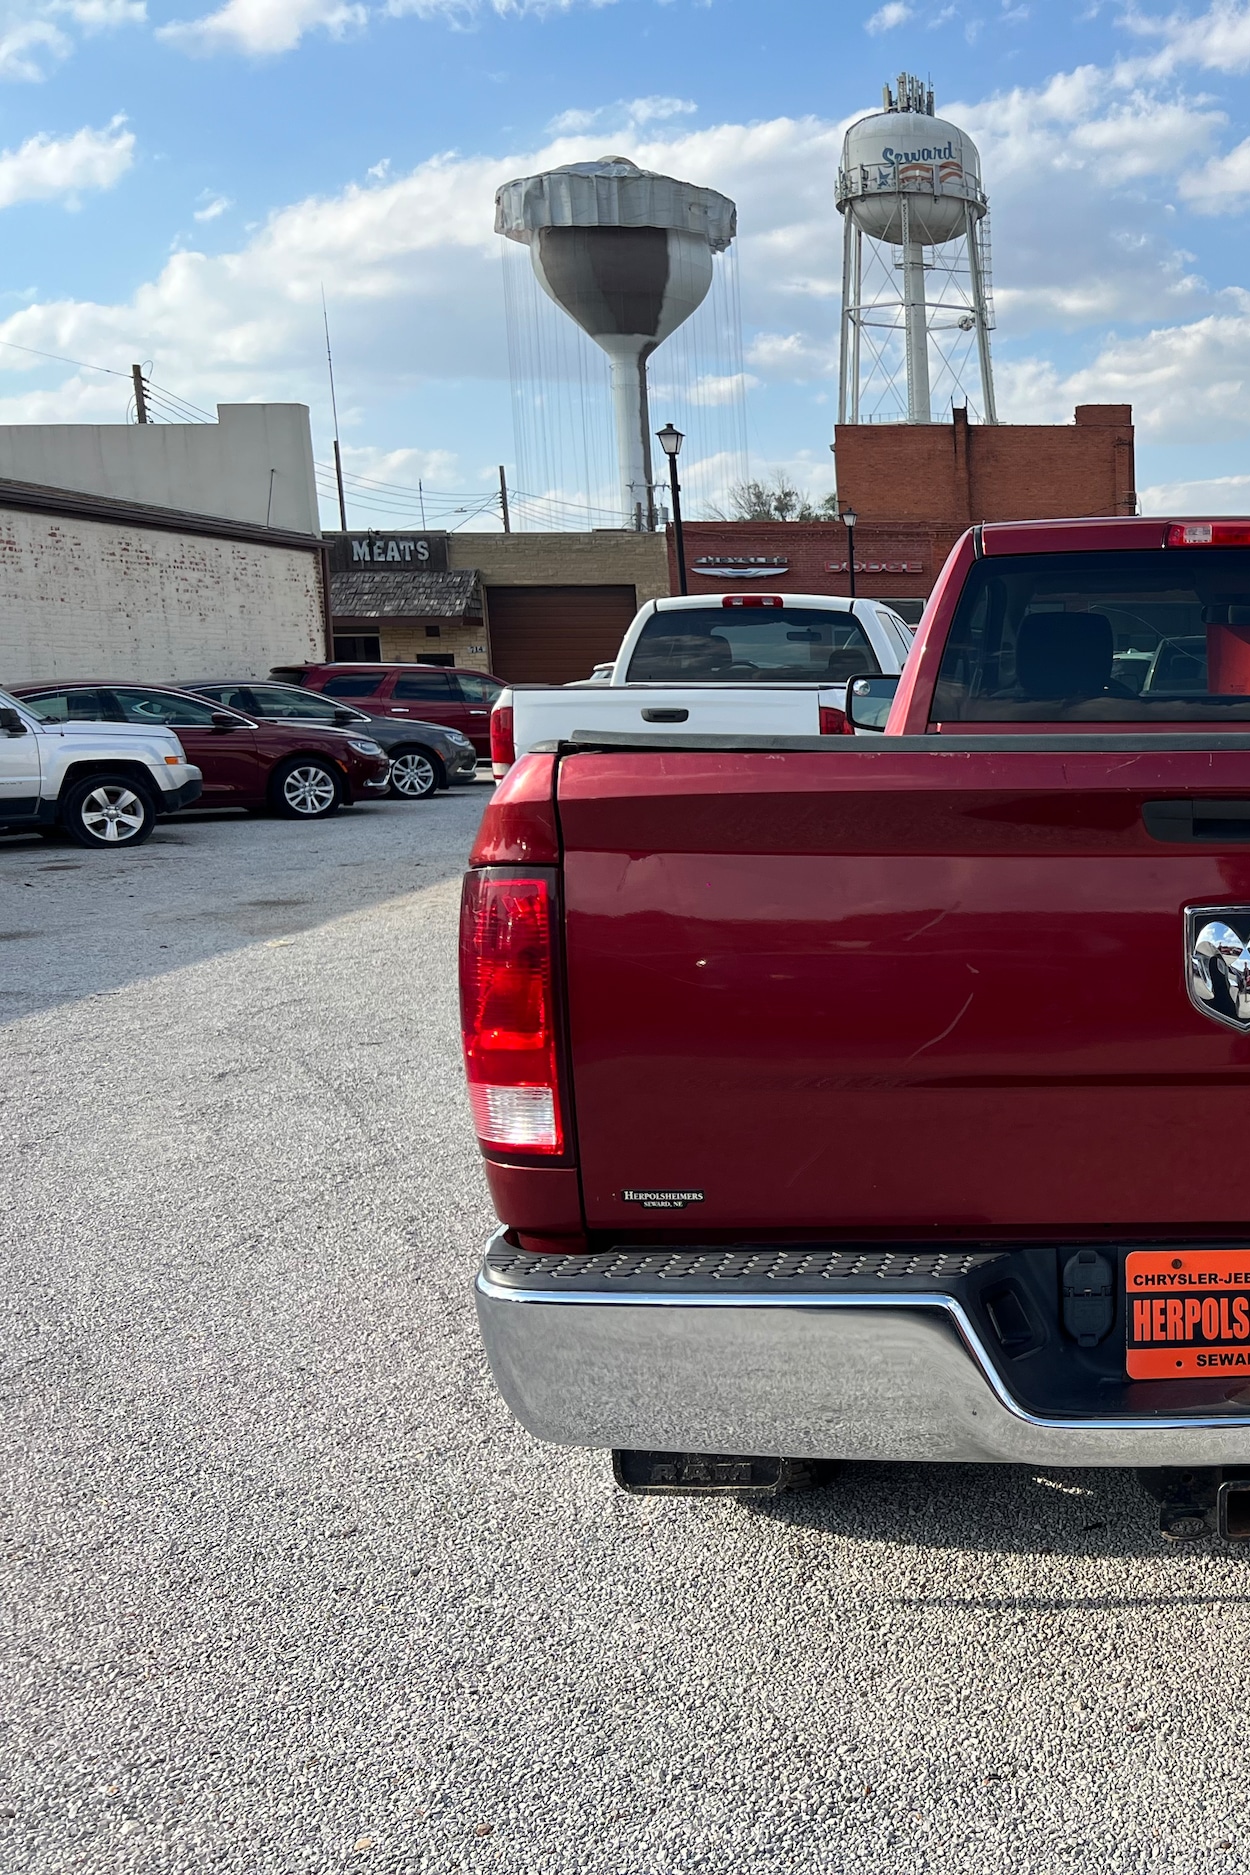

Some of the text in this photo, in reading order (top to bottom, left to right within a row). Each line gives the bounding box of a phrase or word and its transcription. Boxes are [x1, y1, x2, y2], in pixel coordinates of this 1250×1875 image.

[882, 141, 957, 168] Seward
[352, 541, 430, 562] MEATS
[824, 561, 924, 573] DODGE
[624, 1191, 704, 1200] HERPOLSHEIMERS
[651, 1463, 752, 1481] RAM
